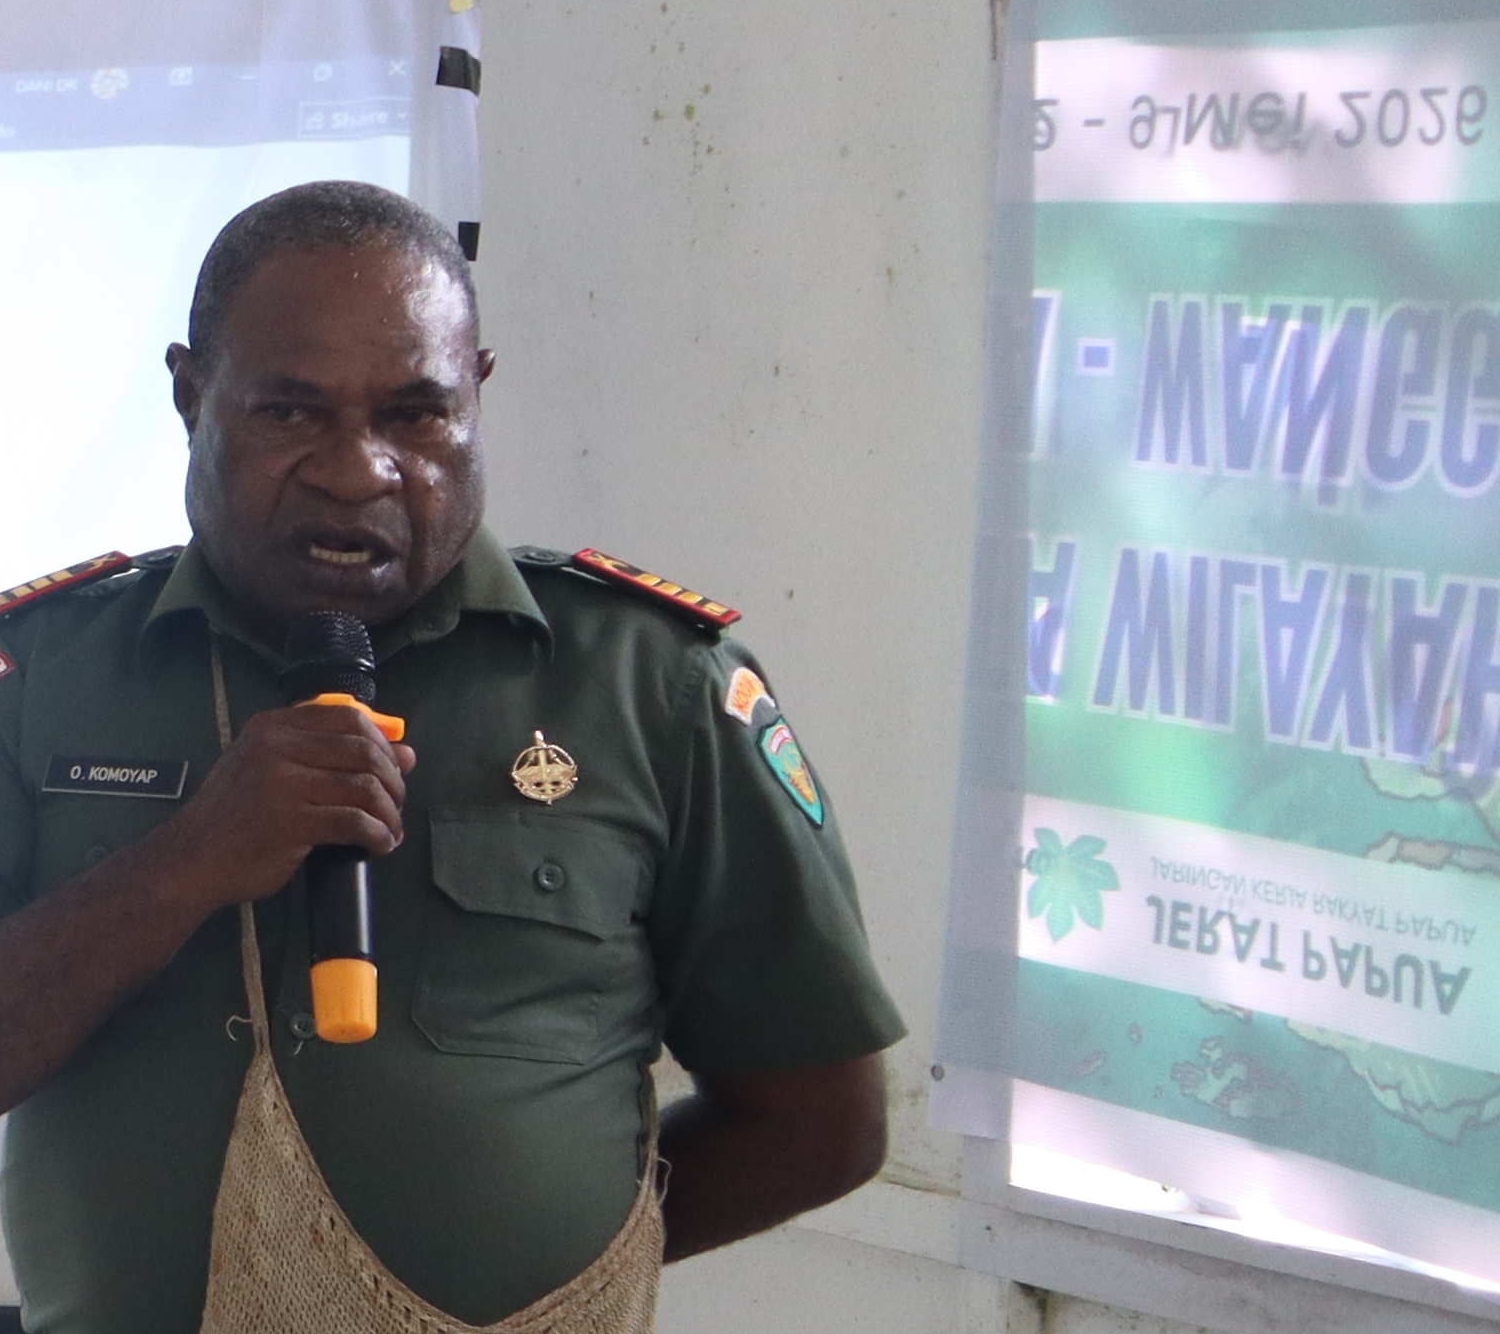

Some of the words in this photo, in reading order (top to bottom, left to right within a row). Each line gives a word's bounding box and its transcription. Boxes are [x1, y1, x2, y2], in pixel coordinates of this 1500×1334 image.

[331, 110, 389, 128] Share
[70, 765, 85, 781] O.
[88, 766, 158, 784] KOMOYAP
